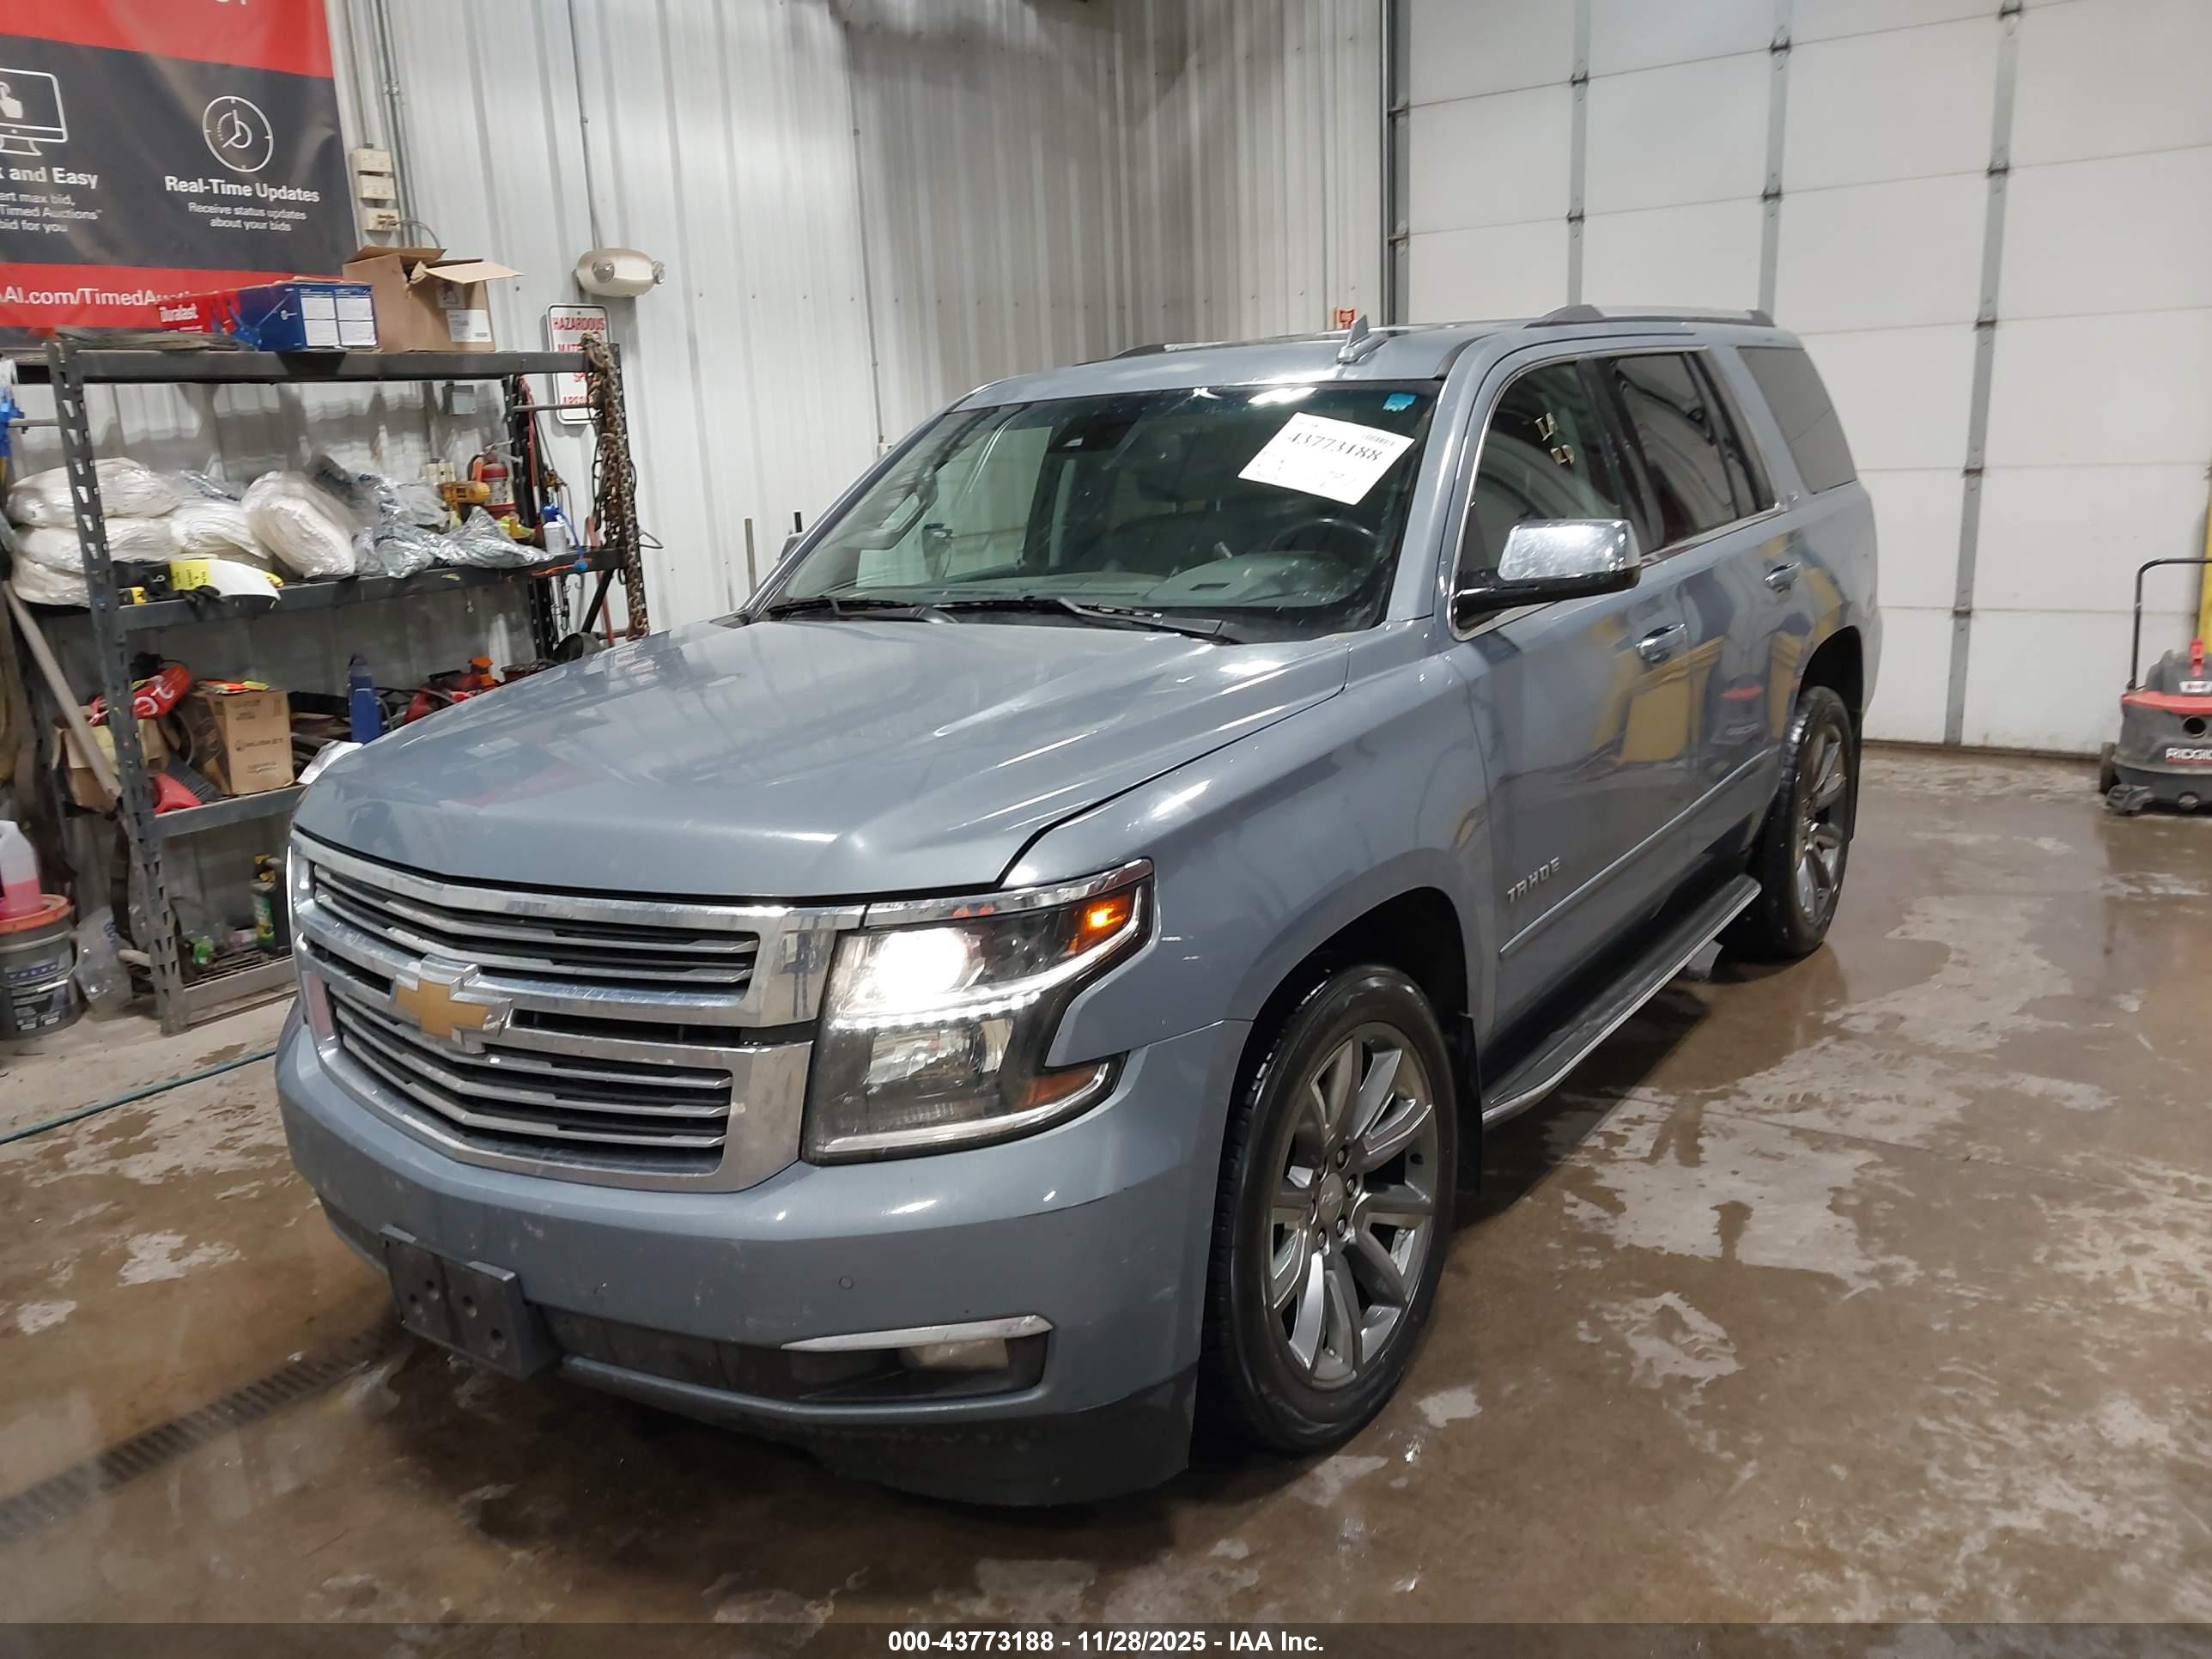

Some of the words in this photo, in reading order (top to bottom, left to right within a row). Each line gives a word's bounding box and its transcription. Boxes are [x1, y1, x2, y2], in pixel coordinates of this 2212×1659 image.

[9, 167, 47, 182] and
[52, 167, 98, 189] Easy
[164, 175, 252, 197] Real-Time
[255, 183, 320, 202] Updates
[188, 202, 232, 215] Receive
[233, 207, 265, 217] status
[266, 210, 307, 221] updates
[21, 219, 40, 231] for
[41, 223, 69, 234] you
[210, 216, 242, 228] about
[243, 220, 268, 231] your
[269, 221, 292, 232] bids
[552, 317, 605, 331] HAZARDOUS
[1507, 855, 1561, 904] TAHOE
